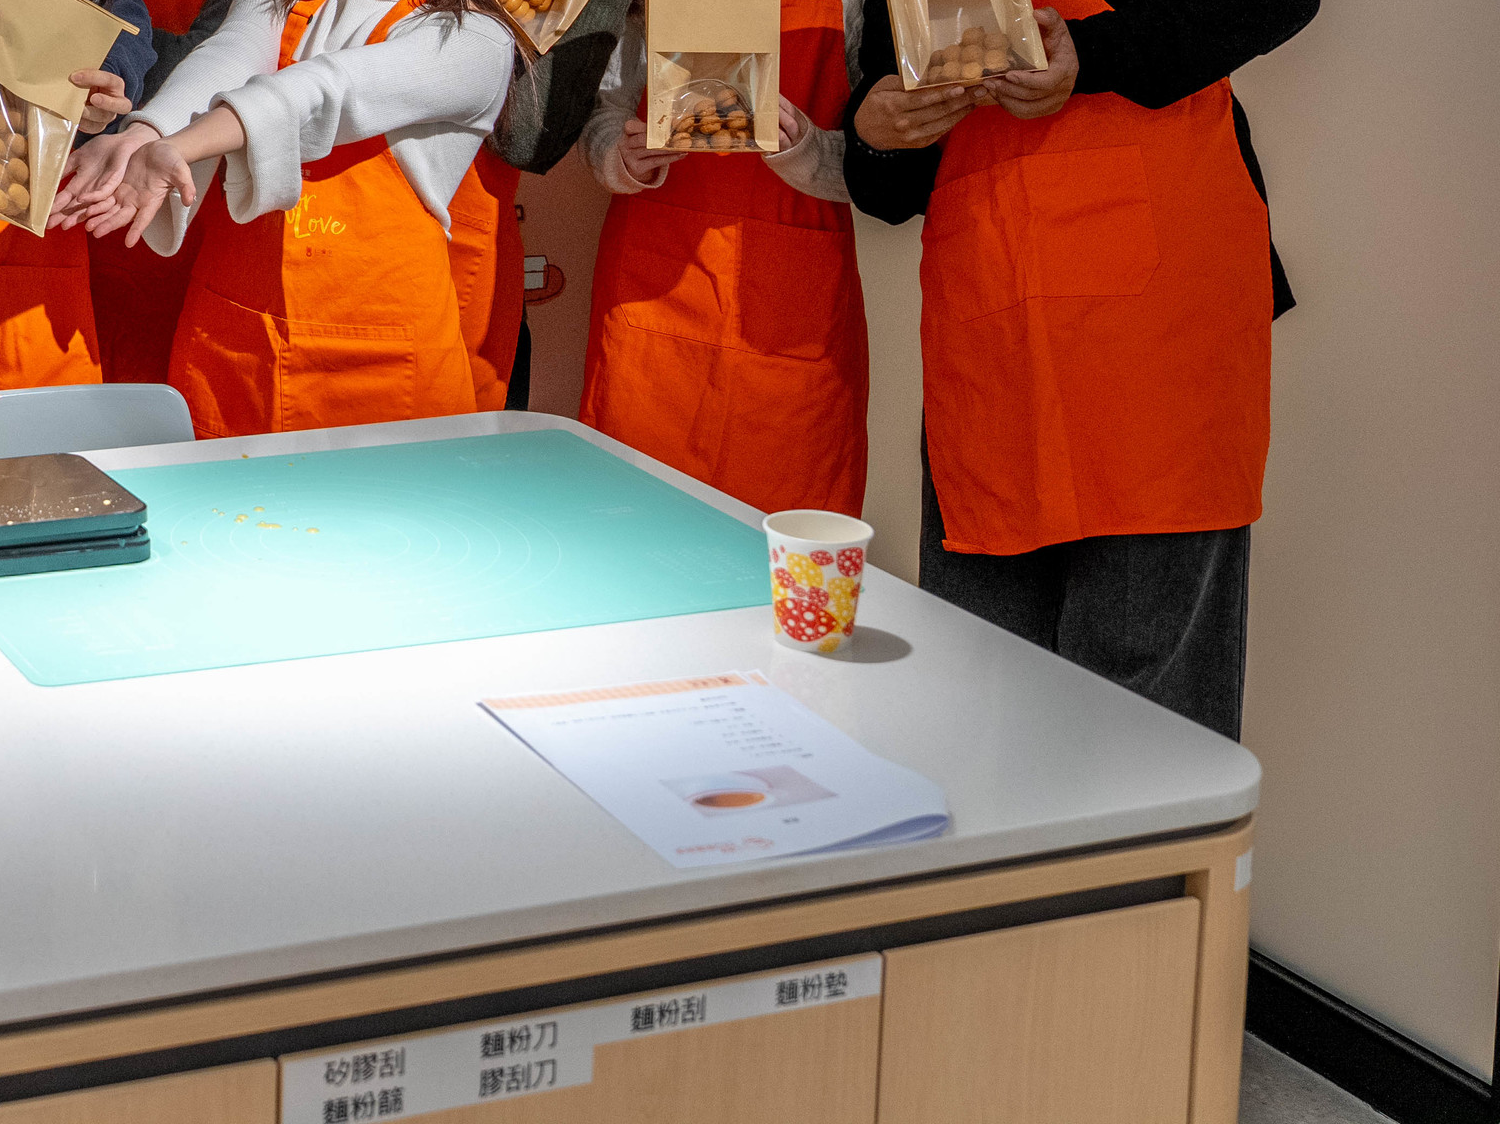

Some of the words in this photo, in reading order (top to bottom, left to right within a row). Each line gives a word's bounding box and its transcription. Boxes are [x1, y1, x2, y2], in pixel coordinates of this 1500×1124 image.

[294, 209, 347, 239] Love
[630, 993, 707, 1033] 麵粉刮
[480, 1021, 558, 1059] 麵粉刀
[323, 1046, 406, 1086] 矽膠刮
[478, 1058, 558, 1098] 膠刮刀
